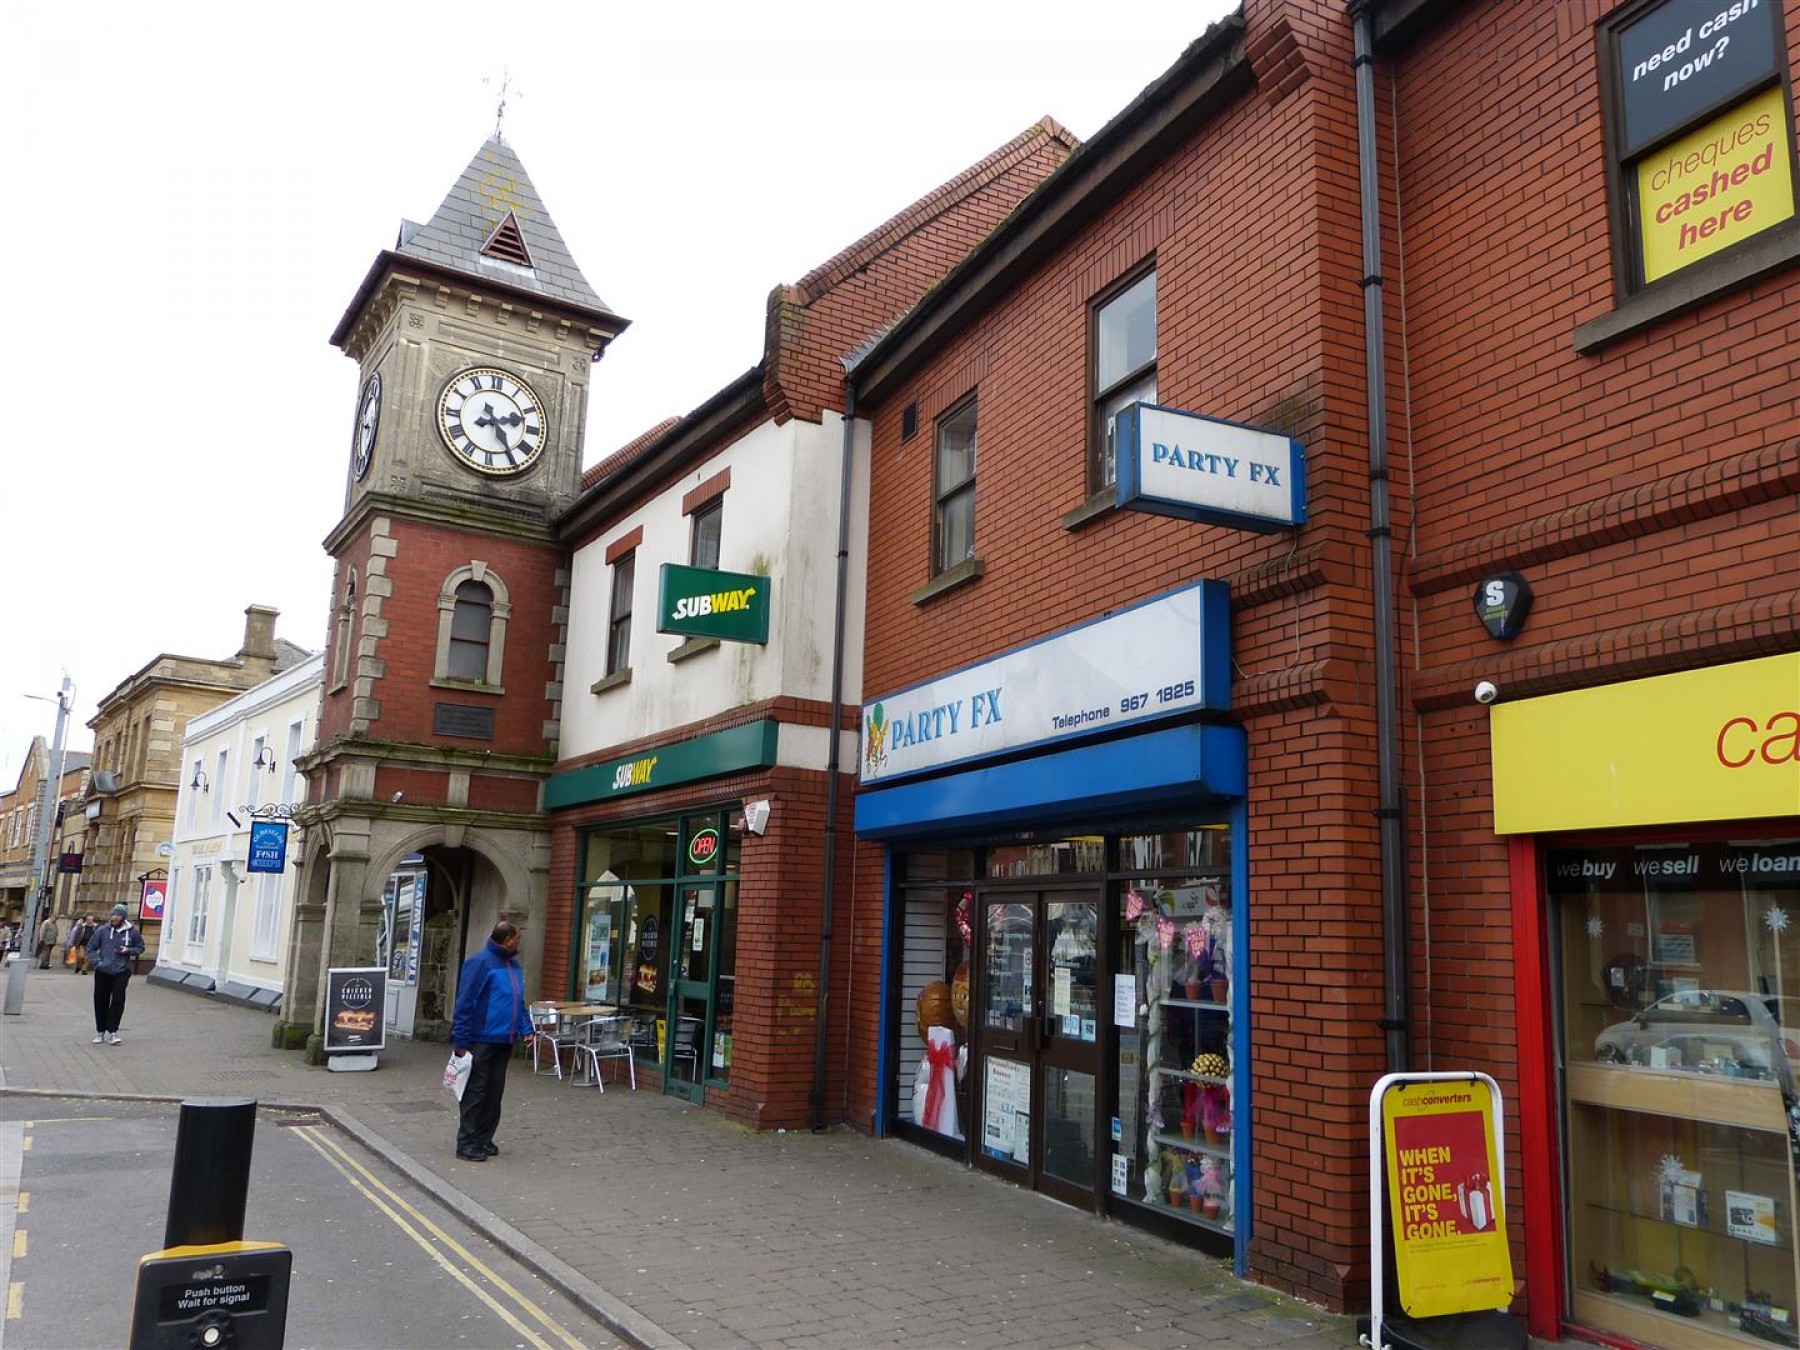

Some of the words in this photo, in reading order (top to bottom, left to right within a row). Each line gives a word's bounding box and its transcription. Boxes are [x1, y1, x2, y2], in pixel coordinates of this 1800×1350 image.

[1632, 28, 1693, 82] need
[1663, 35, 1730, 92] now?
[1651, 113, 1771, 191] cheques
[1655, 142, 1774, 224] cashed
[1678, 199, 1753, 251] here
[1152, 442, 1240, 478] PARTY
[1249, 461, 1281, 487] FX
[672, 586, 756, 620] SUBWAY
[891, 699, 963, 751] PARTY
[971, 686, 1003, 729] FX
[1052, 706, 1110, 730] Telephone
[1120, 693, 1149, 713] 967
[1156, 680, 1195, 703] 1825
[612, 756, 657, 790] SUBWAY
[693, 836, 716, 855] OPEN
[1581, 858, 1617, 879] buy
[1661, 855, 1700, 875] sell
[1400, 1146, 1451, 1167] WHEN
[1401, 1167, 1435, 1186] IT'S
[1403, 1183, 1458, 1204] GONE,
[1405, 1203, 1439, 1223] IT'S
[1406, 1220, 1462, 1240] GONE.
[178, 1298, 200, 1309] Wait
[203, 1298, 217, 1306] for
[219, 1292, 250, 1306] signal
[184, 1289, 211, 1298] Push
[213, 1284, 245, 1296] button
